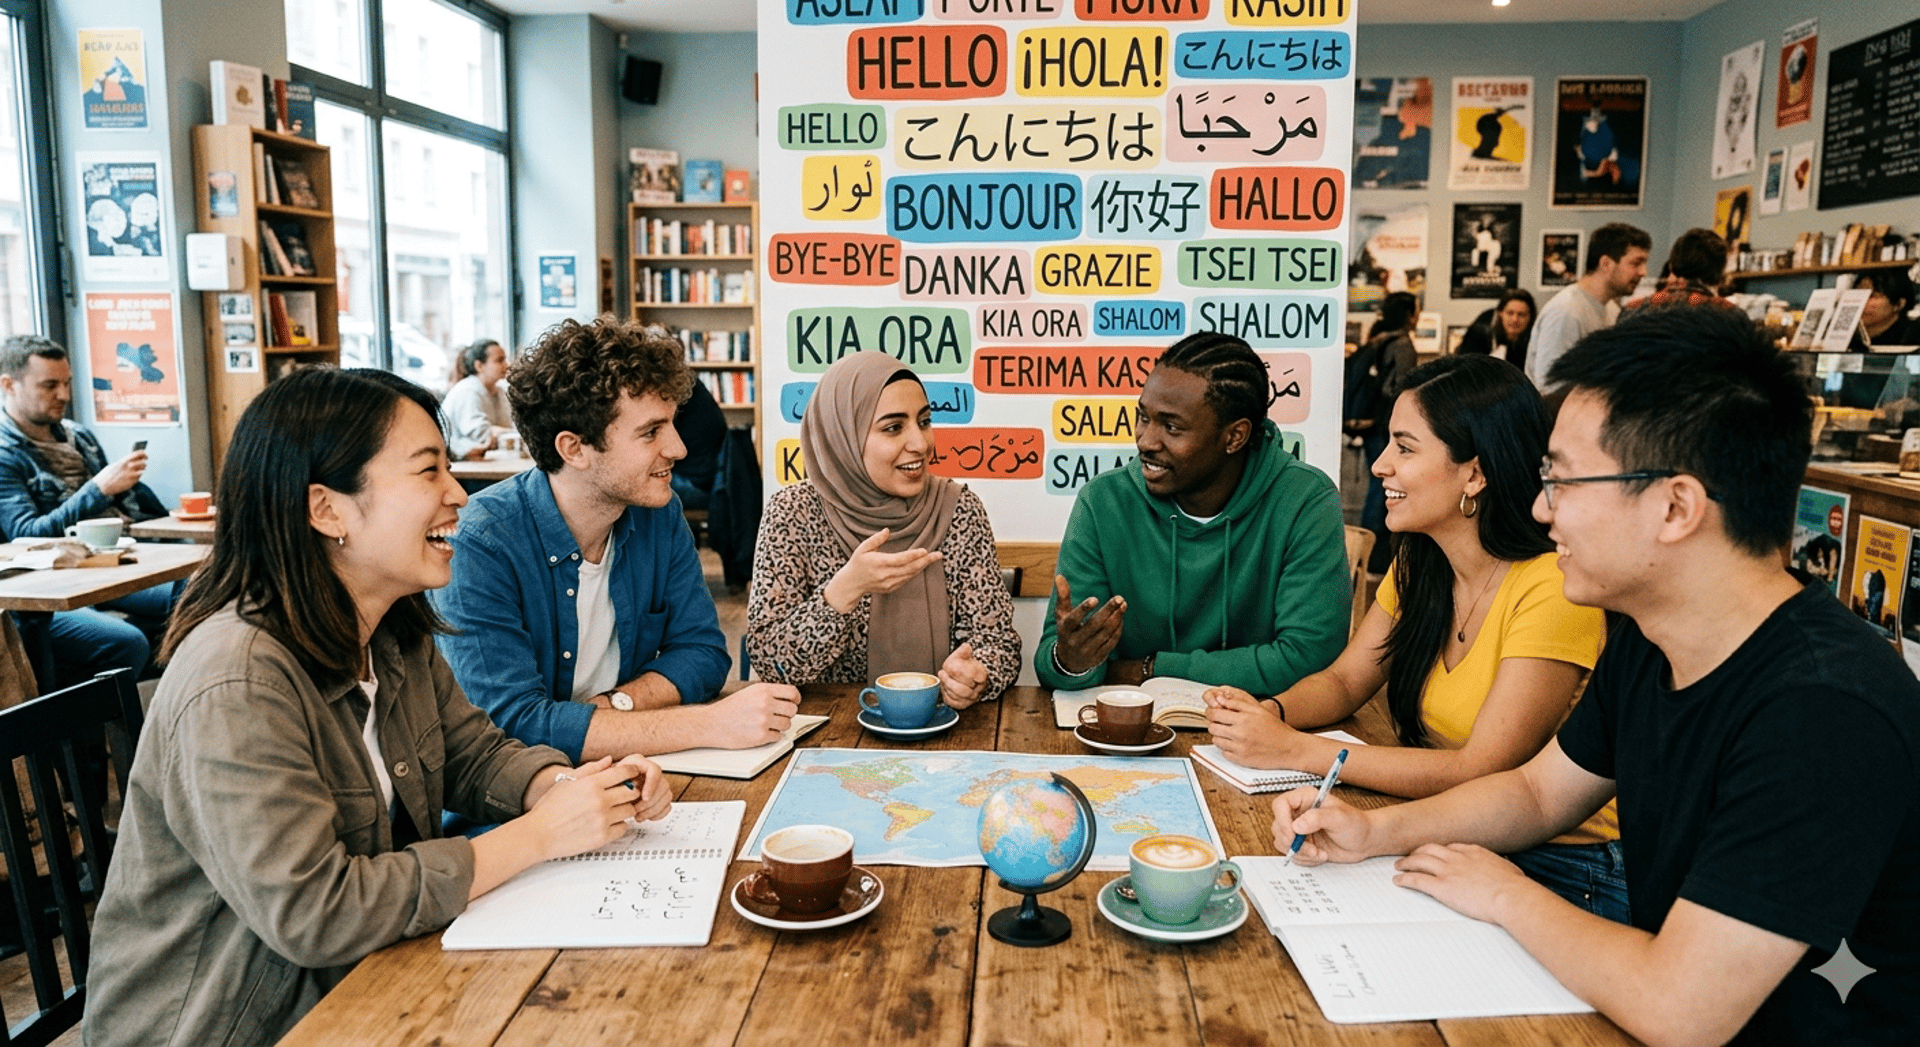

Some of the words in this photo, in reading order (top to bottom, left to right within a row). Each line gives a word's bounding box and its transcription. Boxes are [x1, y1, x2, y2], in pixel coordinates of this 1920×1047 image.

[857, 33, 999, 91] HELLO
[1023, 35, 1163, 90] ¡HOLA!
[1183, 37, 1343, 72] こんにちは
[787, 112, 878, 144] HELLO
[904, 109, 1154, 163] こんにちは
[893, 182, 1077, 232] BONJOUR
[1090, 179, 1201, 234] 你好
[1219, 176, 1337, 222] HALLO
[776, 241, 895, 277] BYE-BYE
[905, 255, 1026, 296] DANKA
[1041, 253, 1153, 288] GRAZIE
[1185, 246, 1256, 282] TSEI
[1267, 247, 1337, 282] TSEI
[982, 309, 1023, 337] KIA
[1031, 309, 1082, 338] ORA
[1098, 306, 1180, 331] SHALOM
[1199, 301, 1329, 339] SHALOM
[796, 315, 862, 365] KIA
[878, 315, 962, 365] ORA
[979, 355, 1088, 388] TERIMA
[1098, 356, 1159, 388] KAS
[1060, 404, 1140, 437] SALA
